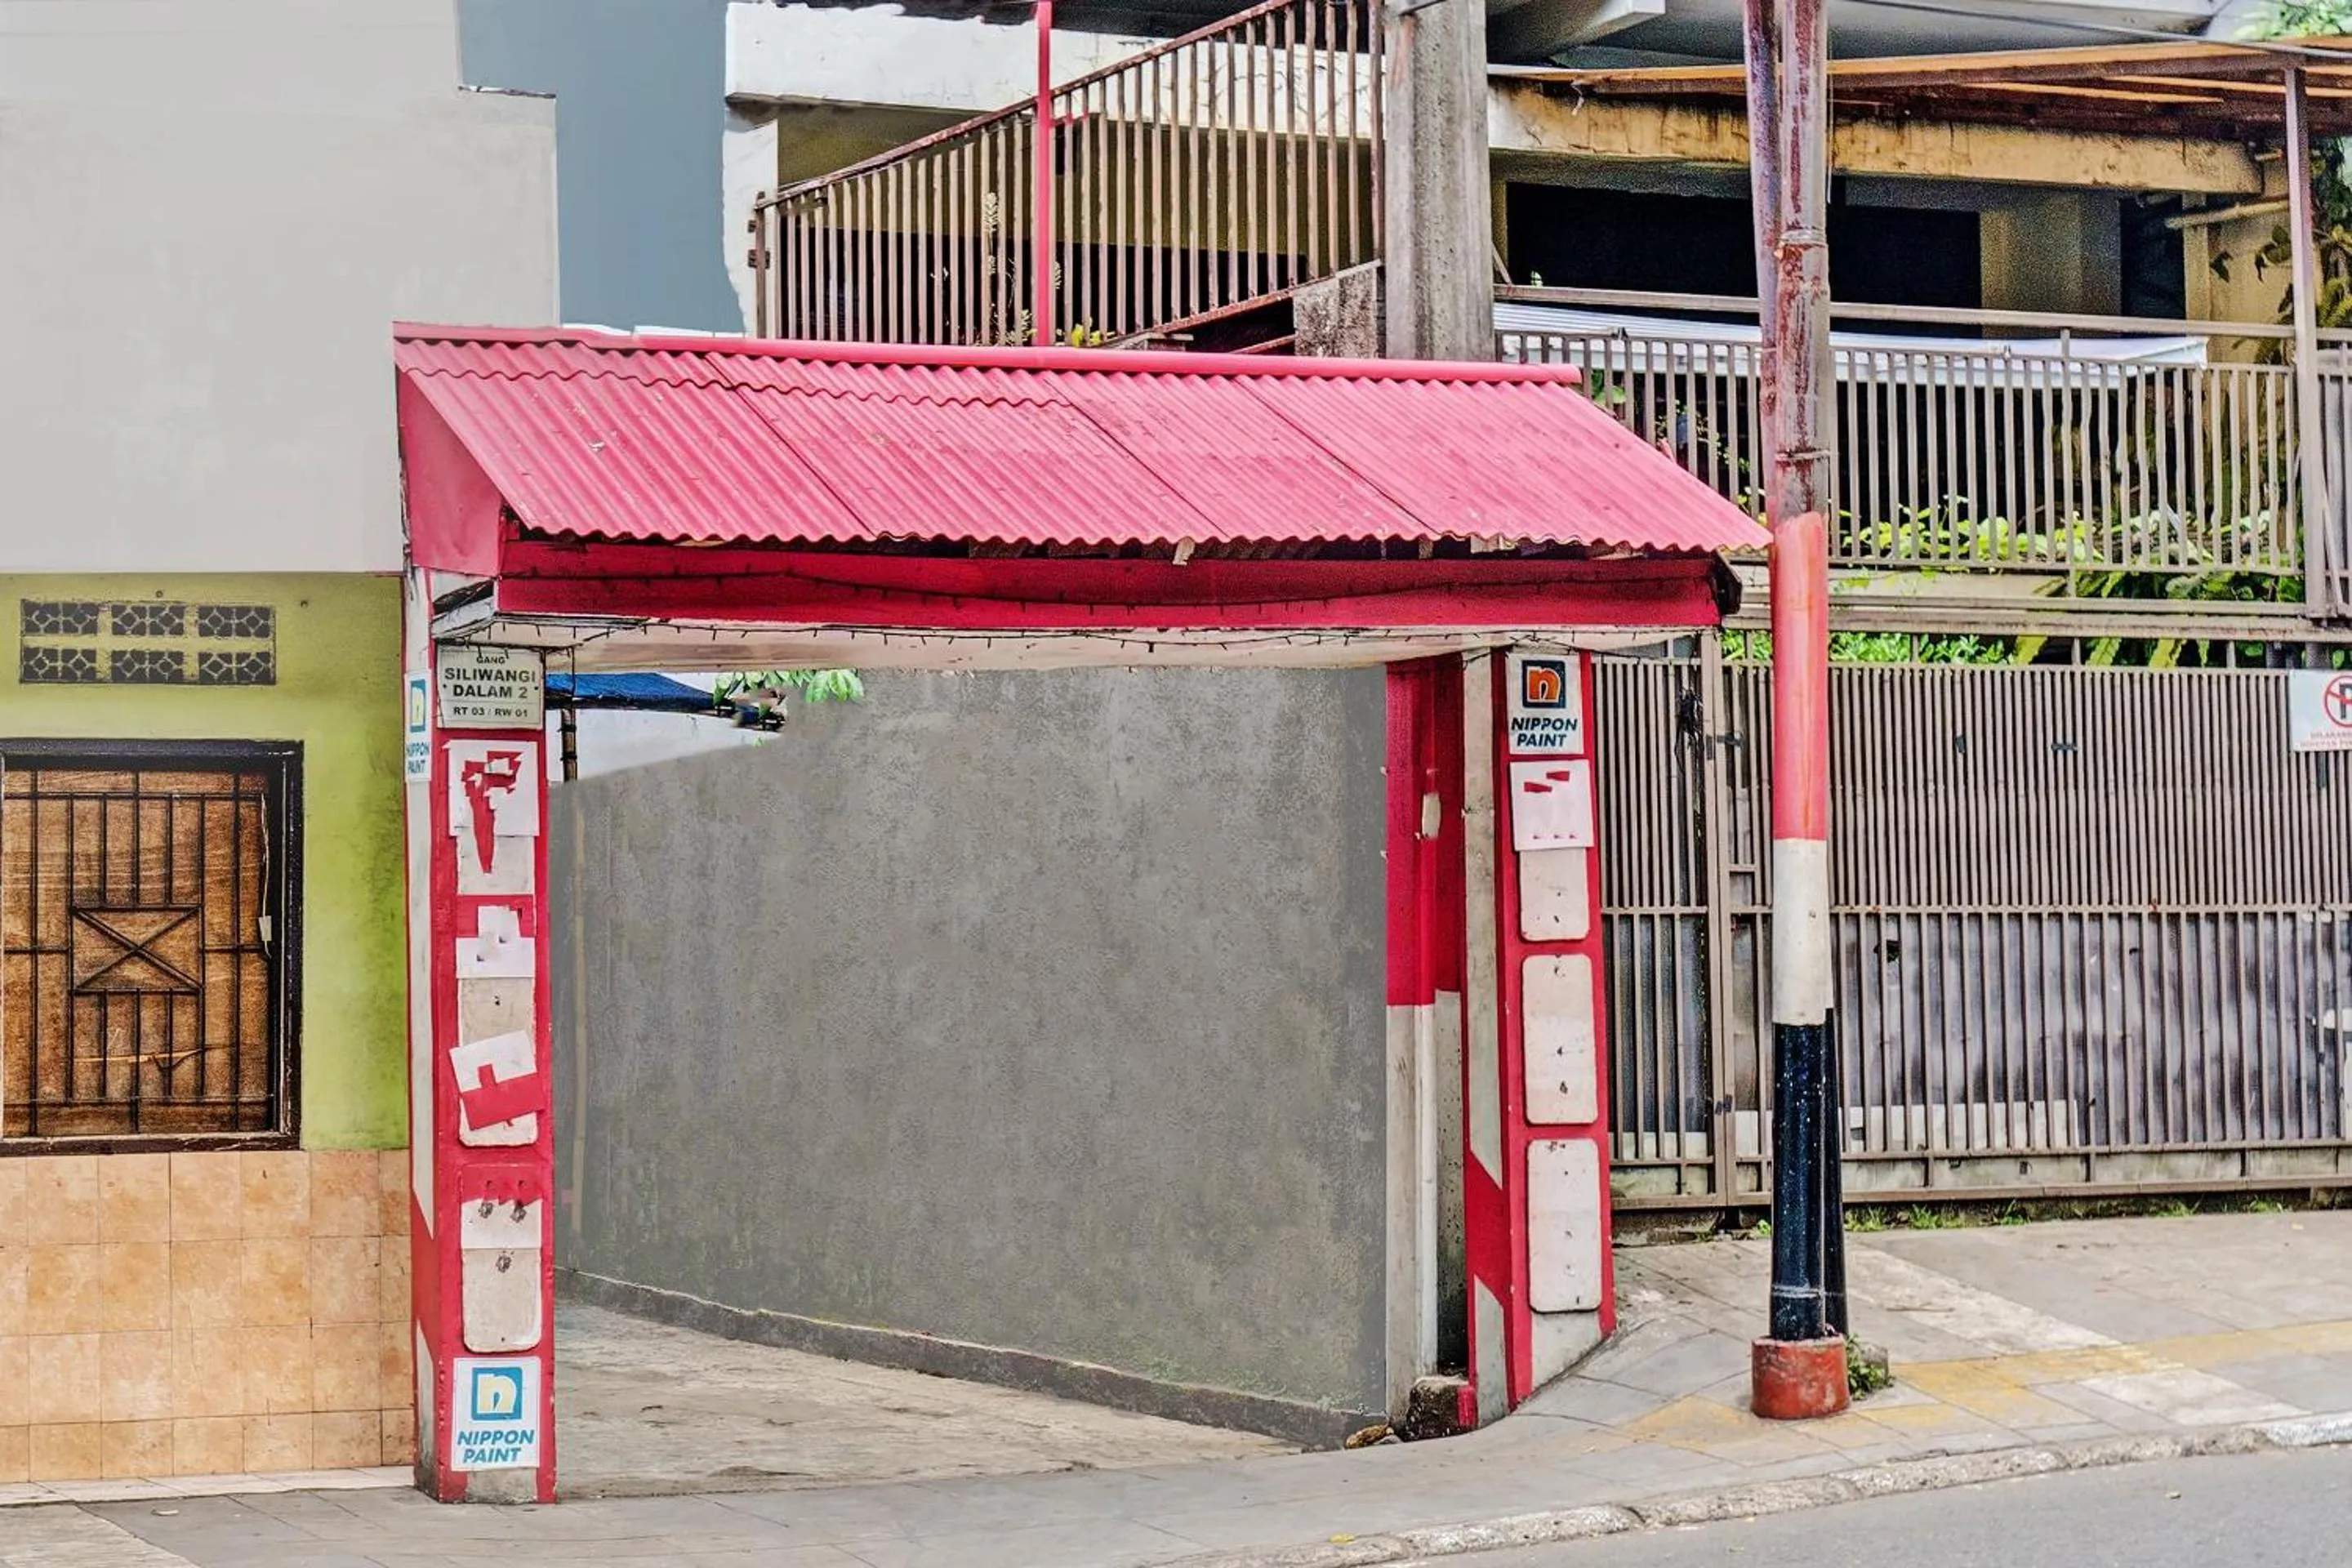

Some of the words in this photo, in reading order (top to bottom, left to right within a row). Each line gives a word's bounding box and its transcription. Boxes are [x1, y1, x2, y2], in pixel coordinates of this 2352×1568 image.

[476, 656, 506, 664] GANG
[444, 667, 536, 683] SILIWANGI
[453, 684, 512, 698] DALAM
[519, 687, 528, 699] 2
[453, 706, 468, 715] RT
[471, 706, 485, 715] 03
[495, 707, 511, 716] RW
[515, 709, 528, 717] 01
[1511, 717, 1578, 731] NIPPON
[1517, 733, 1567, 747] PAINT
[457, 1429, 534, 1446] NIPPON
[462, 1447, 522, 1463] PAINT
